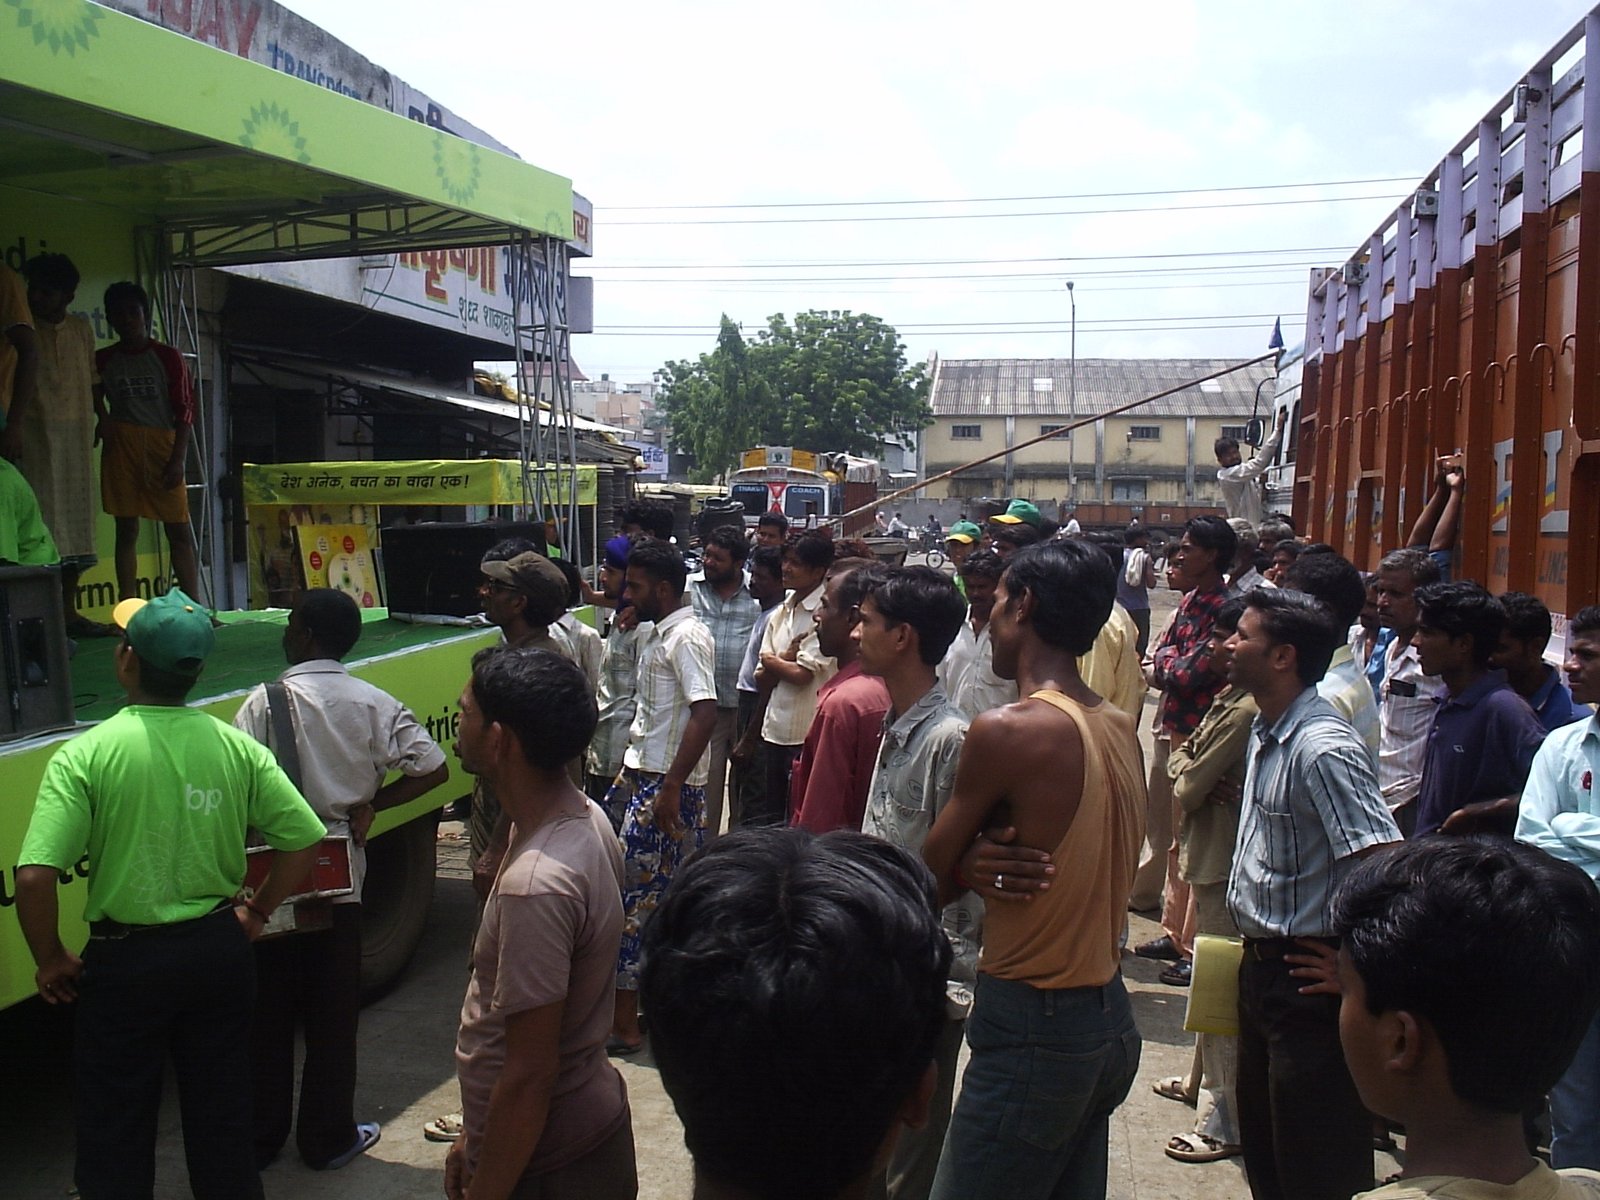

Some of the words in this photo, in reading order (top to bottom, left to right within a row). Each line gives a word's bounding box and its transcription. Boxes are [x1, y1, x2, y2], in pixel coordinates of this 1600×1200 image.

[281, 472, 302, 488] देश
[350, 476, 380, 488] बचत
[384, 476, 402, 488] का
[406, 475, 436, 488] वादा
[186, 783, 222, 816] bp
